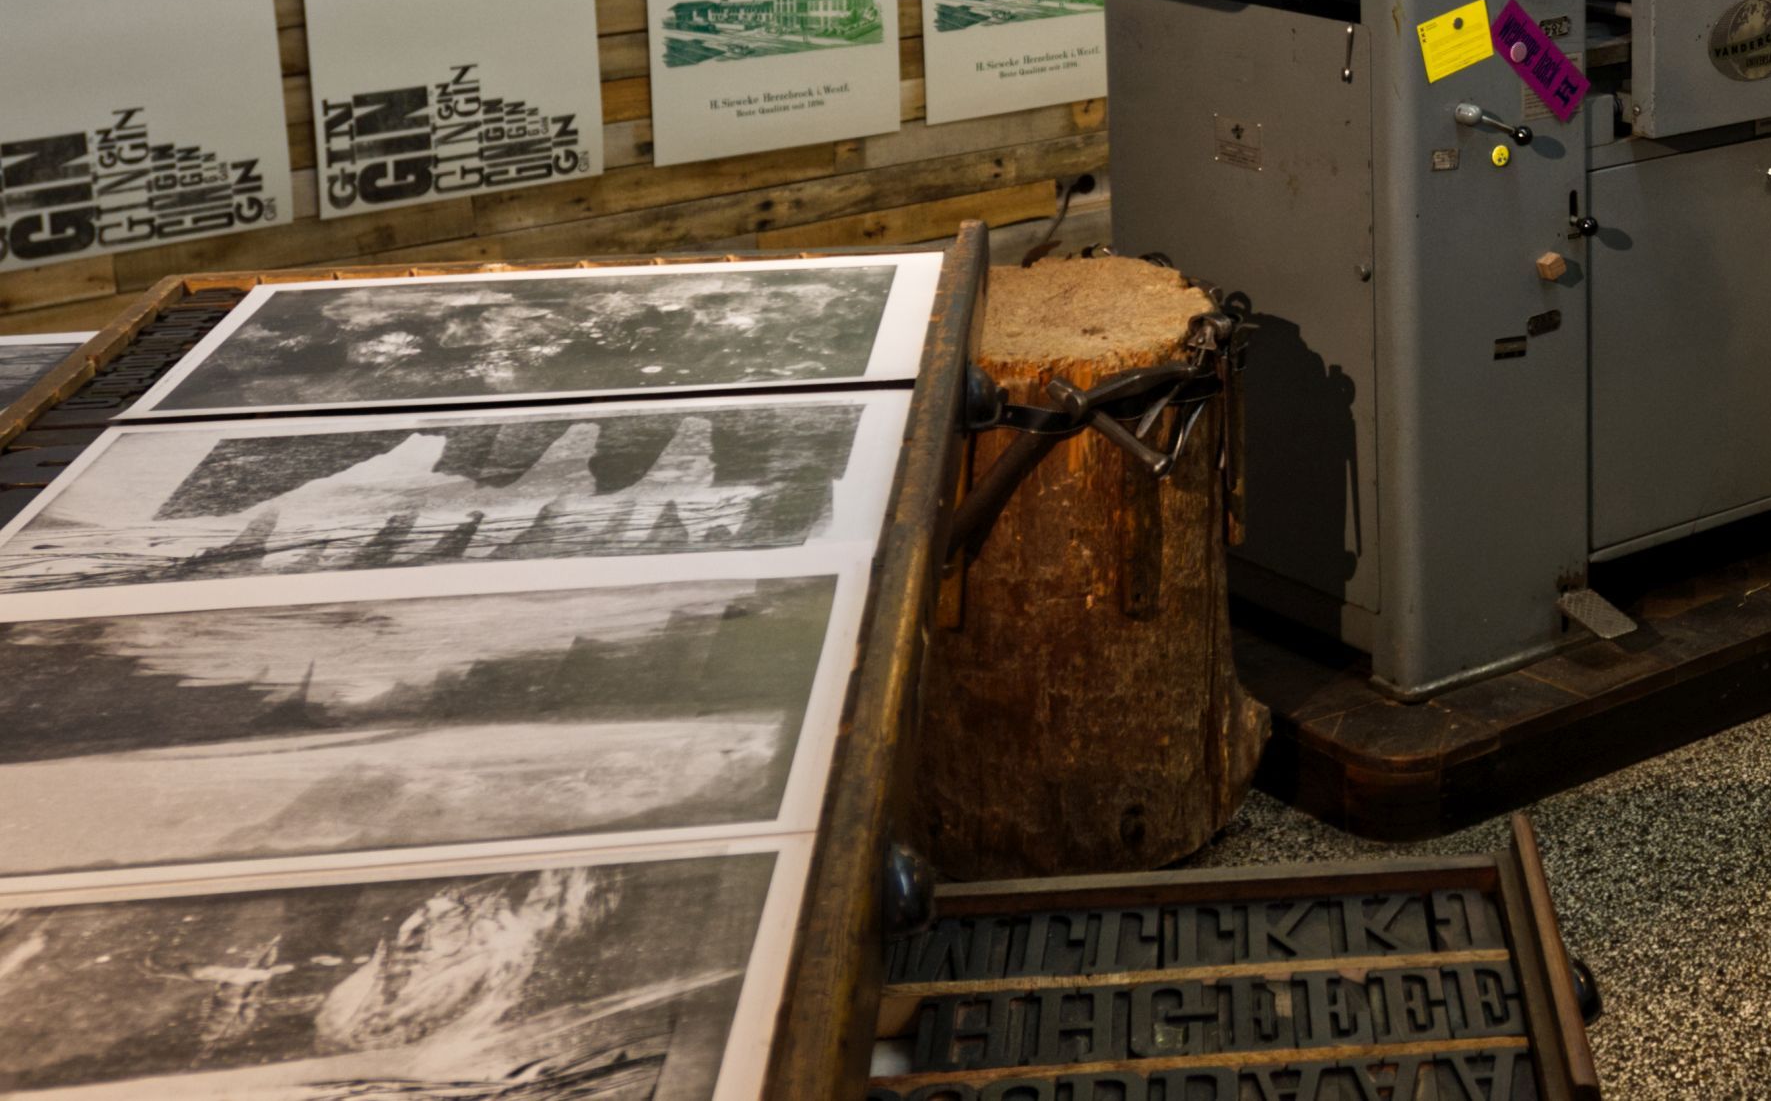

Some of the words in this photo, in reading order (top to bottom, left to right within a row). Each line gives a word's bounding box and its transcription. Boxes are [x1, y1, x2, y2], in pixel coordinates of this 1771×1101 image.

[435, 84, 454, 120] GIN
[450, 64, 482, 118] GIN
[505, 100, 527, 140] GIN
[351, 86, 434, 209] GIN
[483, 99, 505, 142] GIN
[552, 114, 579, 176] GIN
[321, 96, 358, 212] GIN
[431, 118, 485, 195] GIN
[483, 136, 552, 188] GIN
[0, 132, 97, 265] GIN
